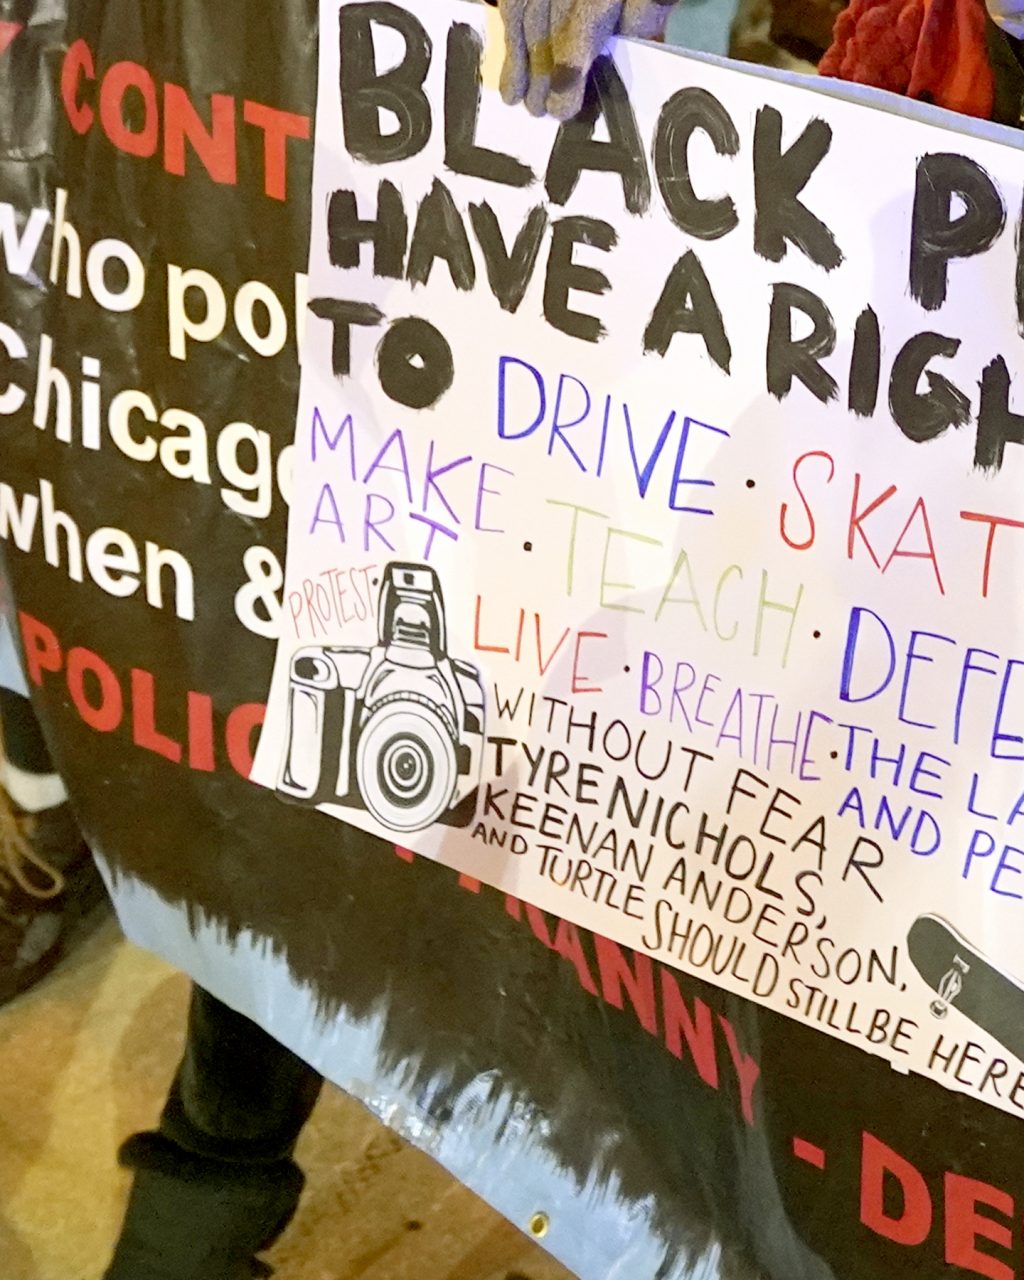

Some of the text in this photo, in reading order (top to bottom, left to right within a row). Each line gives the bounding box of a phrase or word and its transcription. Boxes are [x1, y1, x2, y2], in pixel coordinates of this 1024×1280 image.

[338, 0, 847, 272] BLACK
[328, 176, 618, 344] HAVE
[643, 248, 731, 376] A
[308, 297, 455, 410] TO
[498, 356, 731, 516] DRIVE
[309, 406, 514, 533] MAKE
[0, 478, 285, 639] when &
[289, 565, 378, 639] PROTEST
[309, 482, 459, 561] ART
[546, 499, 804, 669] TEACH
[475, 594, 608, 694] LIVE
[639, 651, 834, 781] BREATHE
[838, 723, 951, 799] THE
[472, 821, 647, 921] AND TURTLE
[483, 783, 654, 883] KEENAN
[487, 736, 828, 930] TYRE NICHOLS,
[494, 683, 885, 904] WITHOUT FEAR
[837, 787, 941, 856] AND
[642, 898, 780, 998] SHOULD
